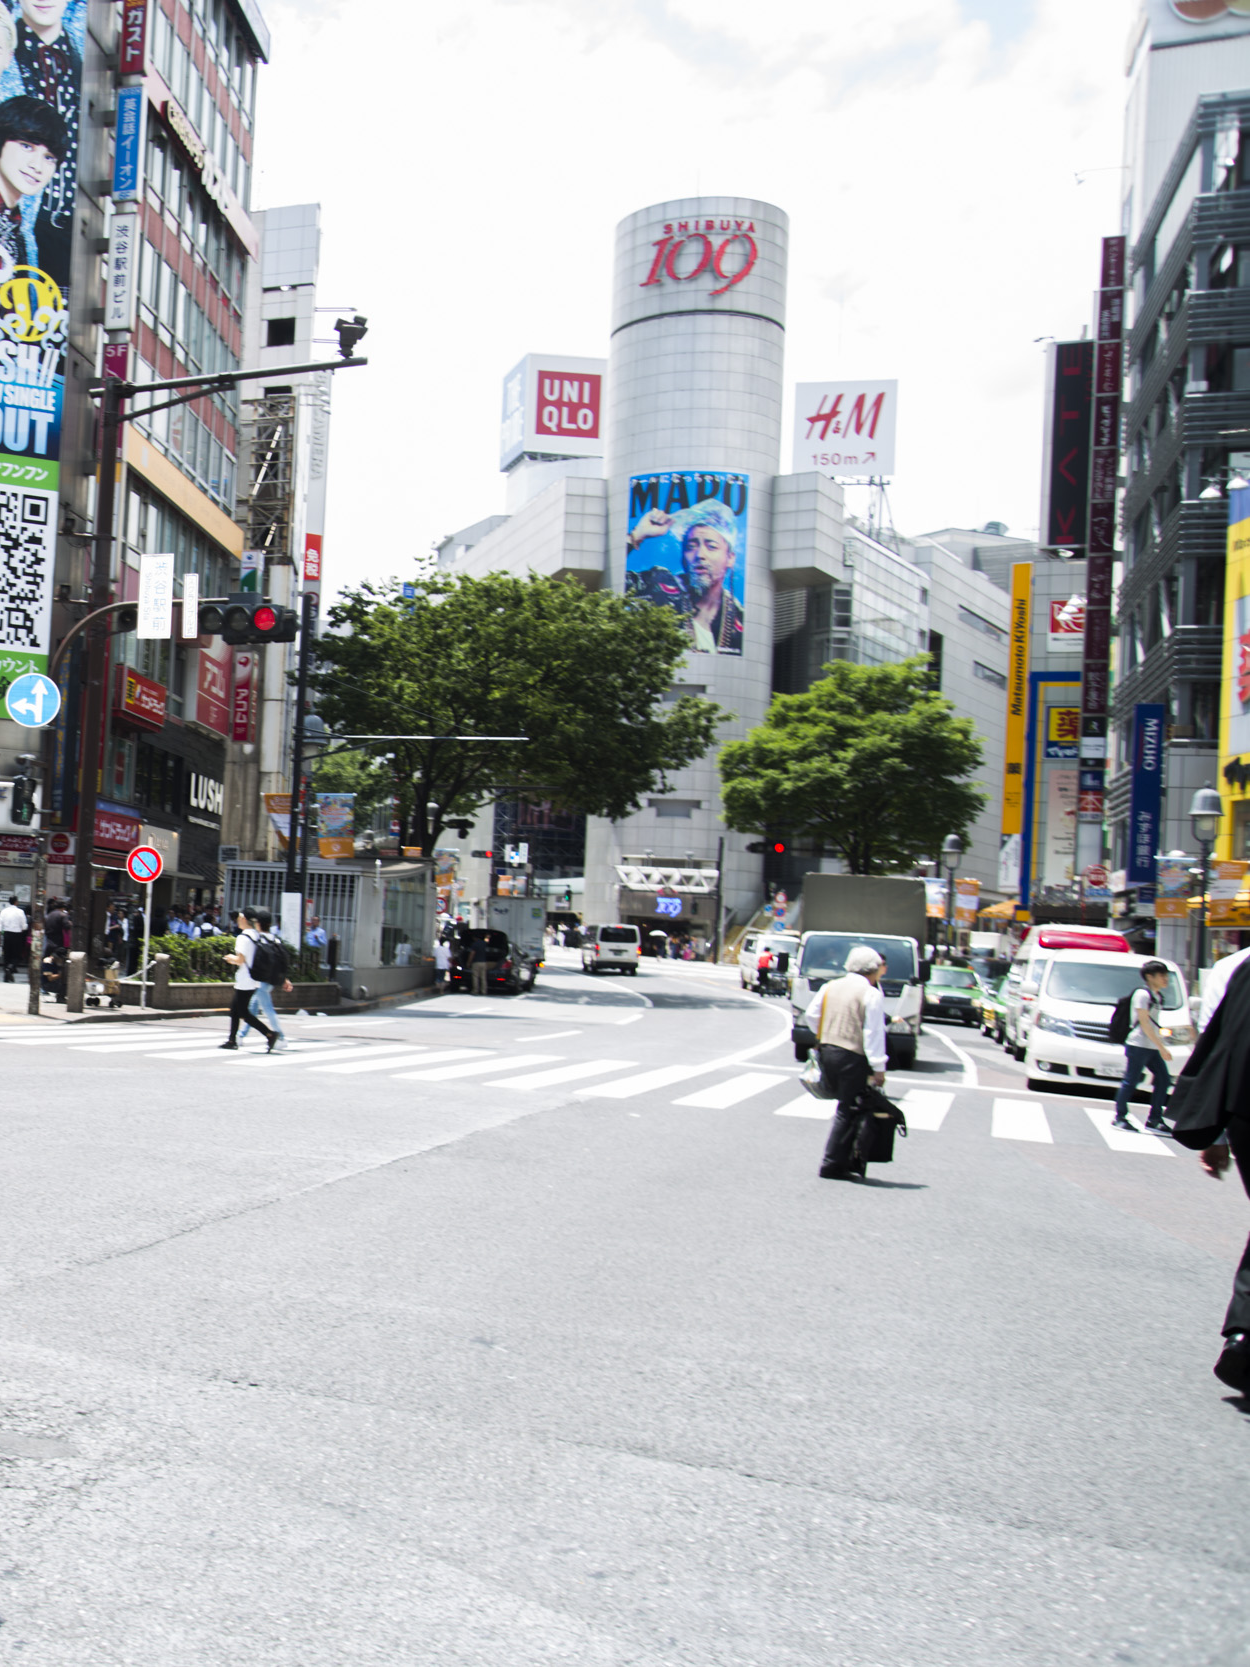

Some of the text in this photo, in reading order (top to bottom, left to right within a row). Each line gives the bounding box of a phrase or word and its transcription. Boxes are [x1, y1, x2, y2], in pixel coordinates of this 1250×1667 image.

[126, 7, 145, 62] ガスト
[662, 219, 757, 235] SHIBUYA
[638, 233, 758, 297] 109
[106, 345, 128, 358] 5F
[3, 383, 57, 412] SINGLE
[543, 378, 590, 404] UNI
[542, 405, 595, 432] QLO
[805, 392, 886, 441] H&M
[812, 452, 859, 466] 150m
[235, 688, 249, 723] アコム
[190, 772, 224, 816] LUSH
